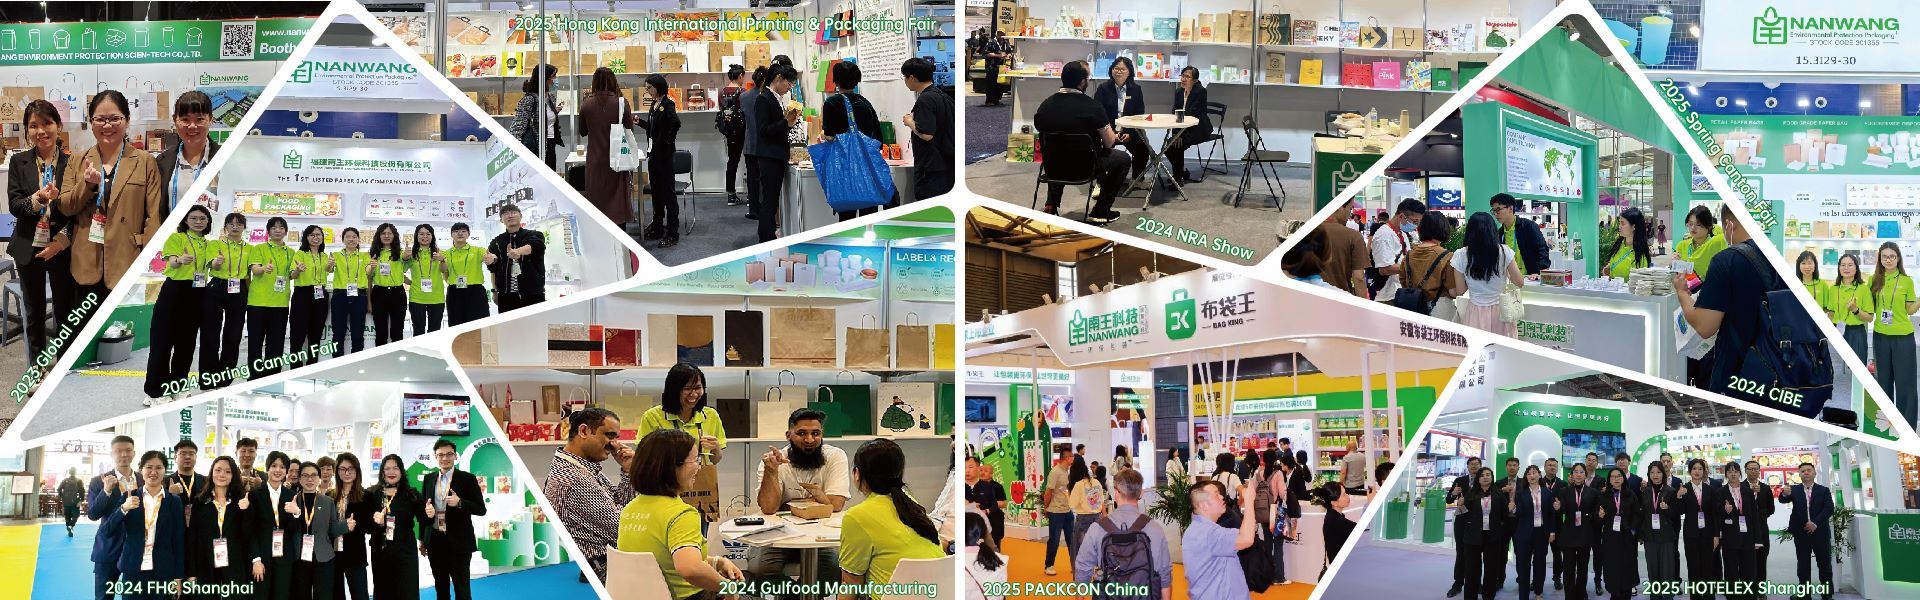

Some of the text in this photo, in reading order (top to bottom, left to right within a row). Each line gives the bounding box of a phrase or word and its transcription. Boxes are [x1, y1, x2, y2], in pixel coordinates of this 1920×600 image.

[1790, 17, 1899, 30] NANWANG
[259, 42, 297, 54] Booth
[18, 52, 73, 61] ENVIRONMENT
[75, 52, 124, 60] PROTECTION
[125, 51, 171, 59] SCIEN-TECH
[315, 62, 418, 73] NANWANG
[494, 149, 515, 171] RECE
[940, 254, 956, 263] RE
[1201, 291, 1256, 320] 布袋王
[1089, 308, 1138, 331] 南王科技
[1228, 318, 1244, 328] KING
[1089, 326, 1139, 343] NANWANG
